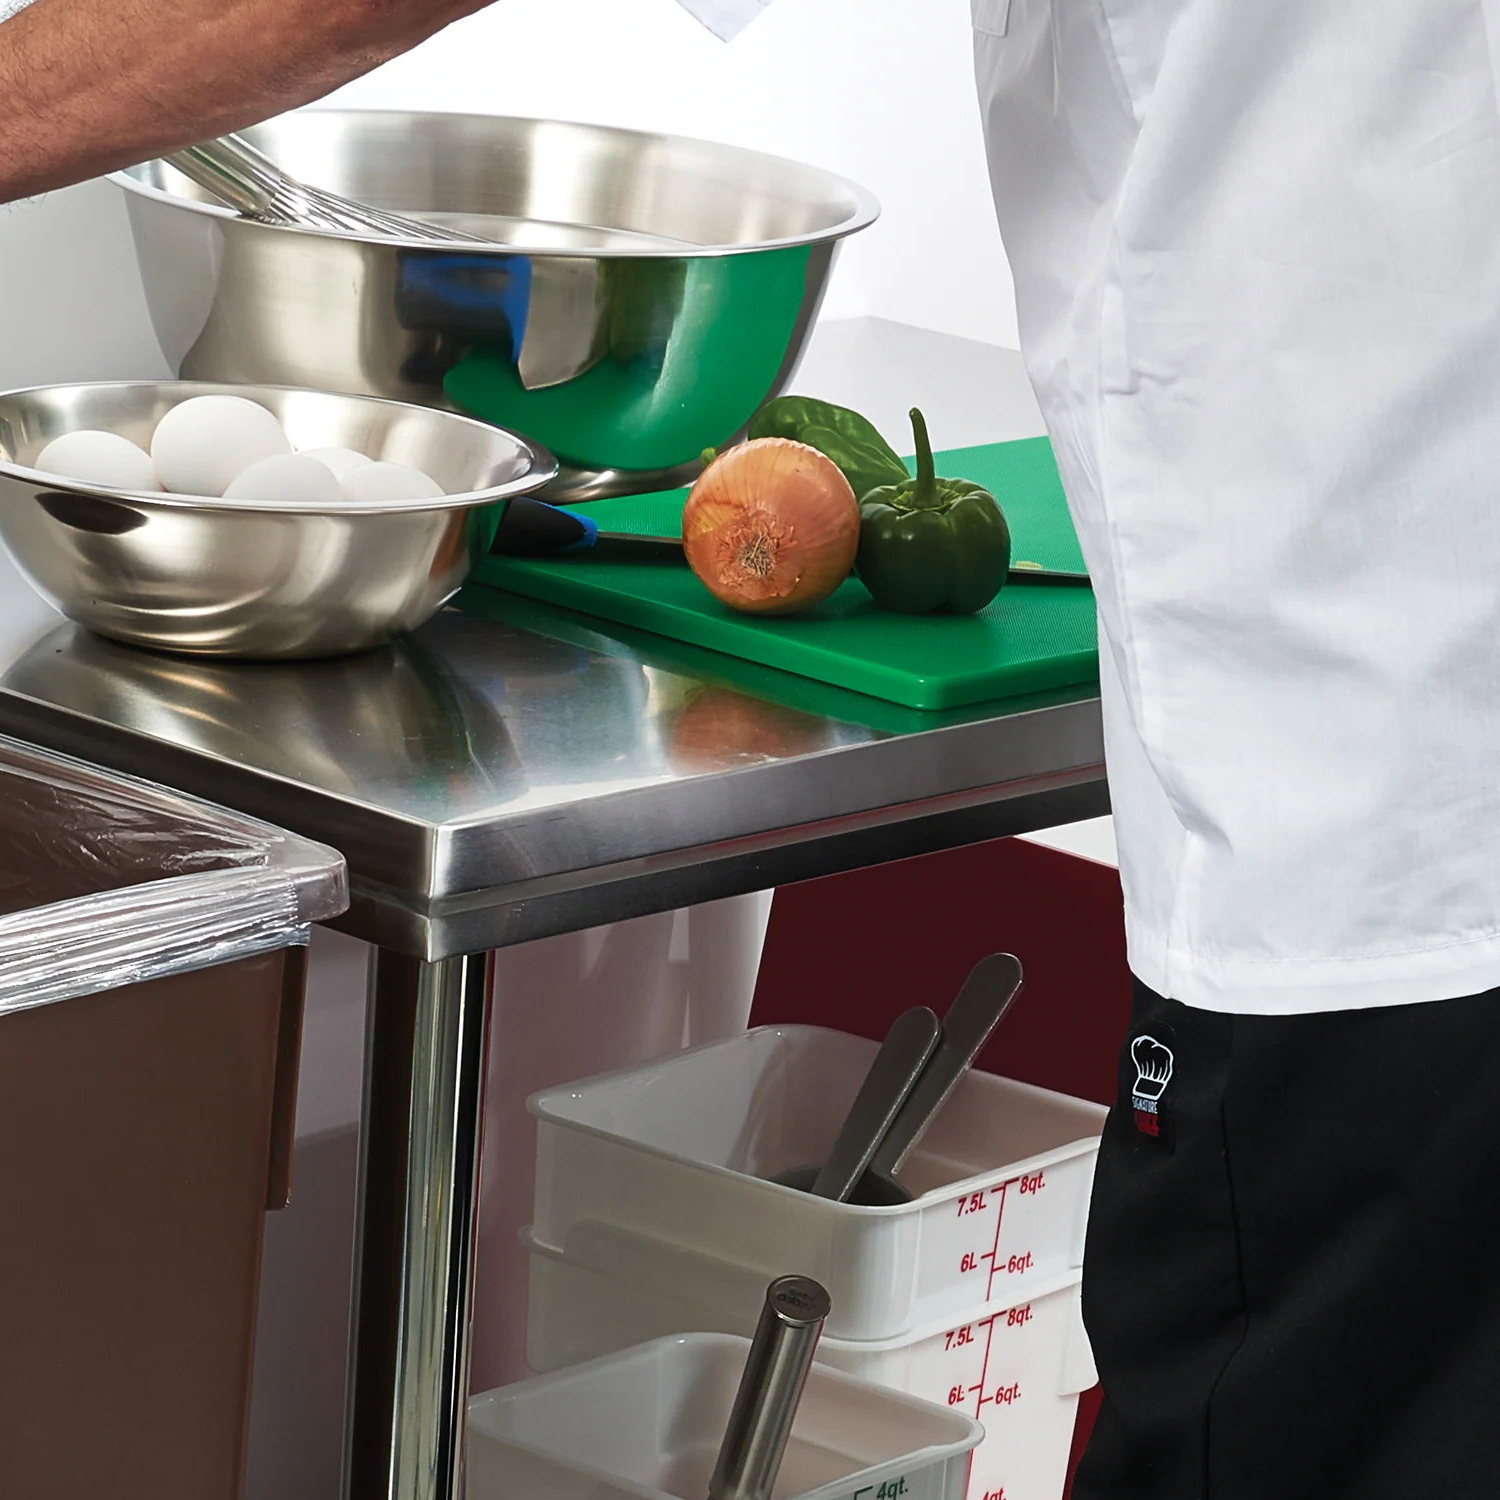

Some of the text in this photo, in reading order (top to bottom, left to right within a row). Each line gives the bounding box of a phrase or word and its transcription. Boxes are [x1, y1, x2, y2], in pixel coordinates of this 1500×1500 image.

[1019, 1171, 1045, 1196] 8qt.
[957, 1191, 987, 1217] 7.5L
[960, 1253, 978, 1273] 6L
[1007, 1251, 1034, 1275] 6qt.
[1007, 1304, 1033, 1328] 8qt.
[945, 1325, 974, 1352] 7.5L
[948, 1386, 965, 1406] 6L
[995, 1383, 1021, 1406] 6qt.
[876, 1476, 909, 1500] 4qt.
